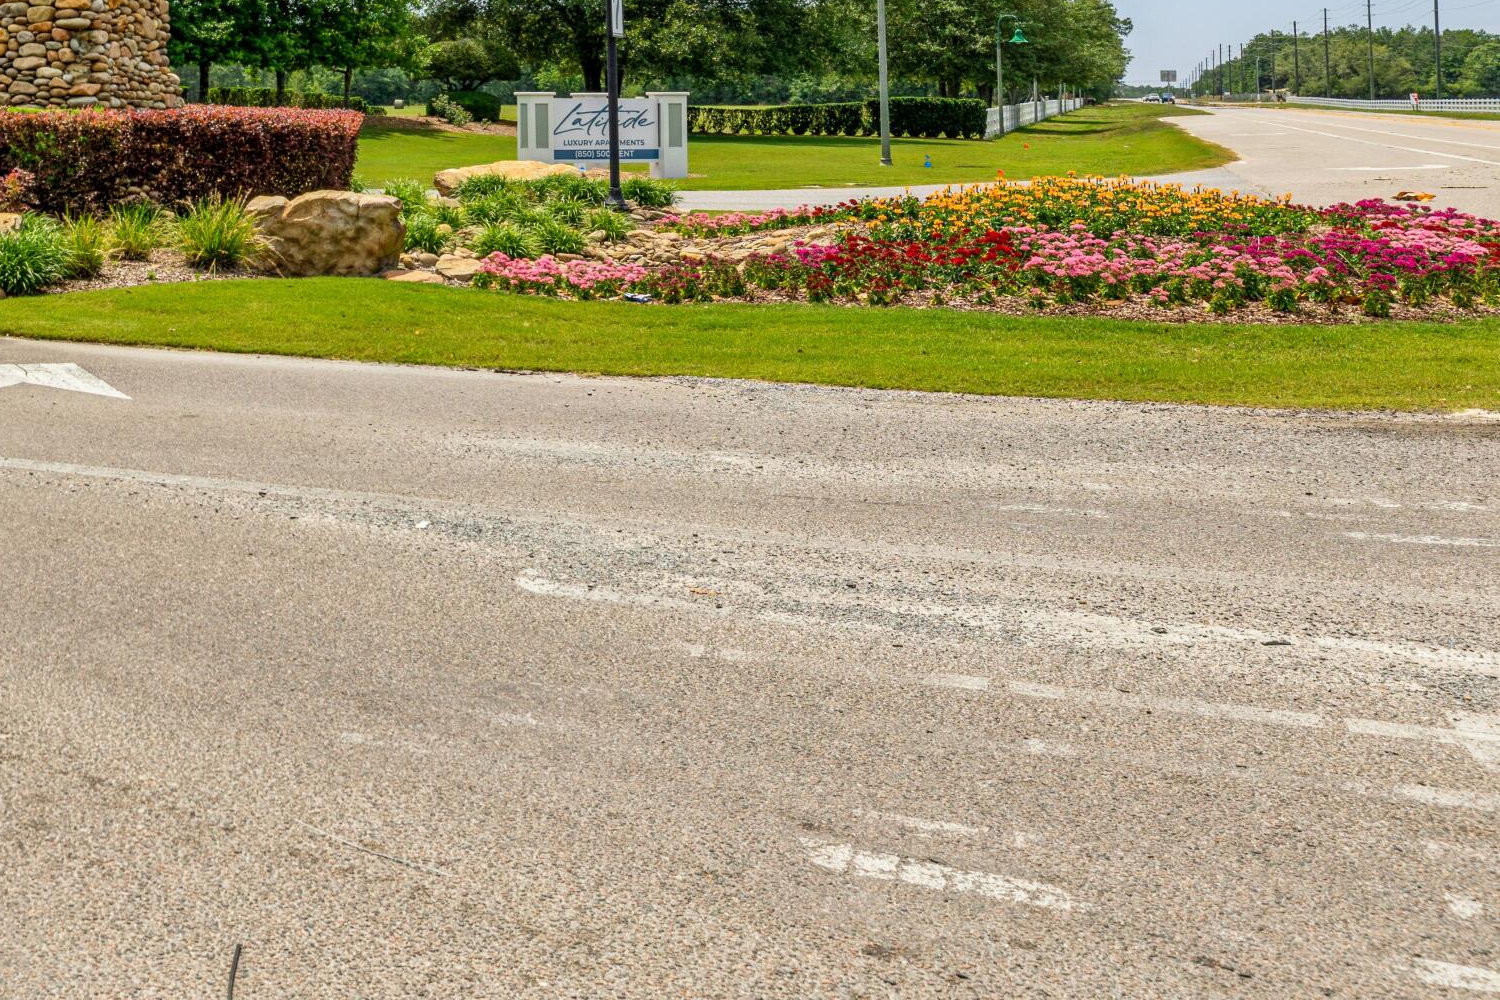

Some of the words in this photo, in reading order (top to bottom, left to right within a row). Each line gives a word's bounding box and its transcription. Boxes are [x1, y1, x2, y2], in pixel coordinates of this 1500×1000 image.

[563, 139, 593, 147] LUXURY
[595, 139, 645, 147] APAMENTS
[575, 150, 595, 159] (850)
[596, 150, 635, 158] 500ENT
